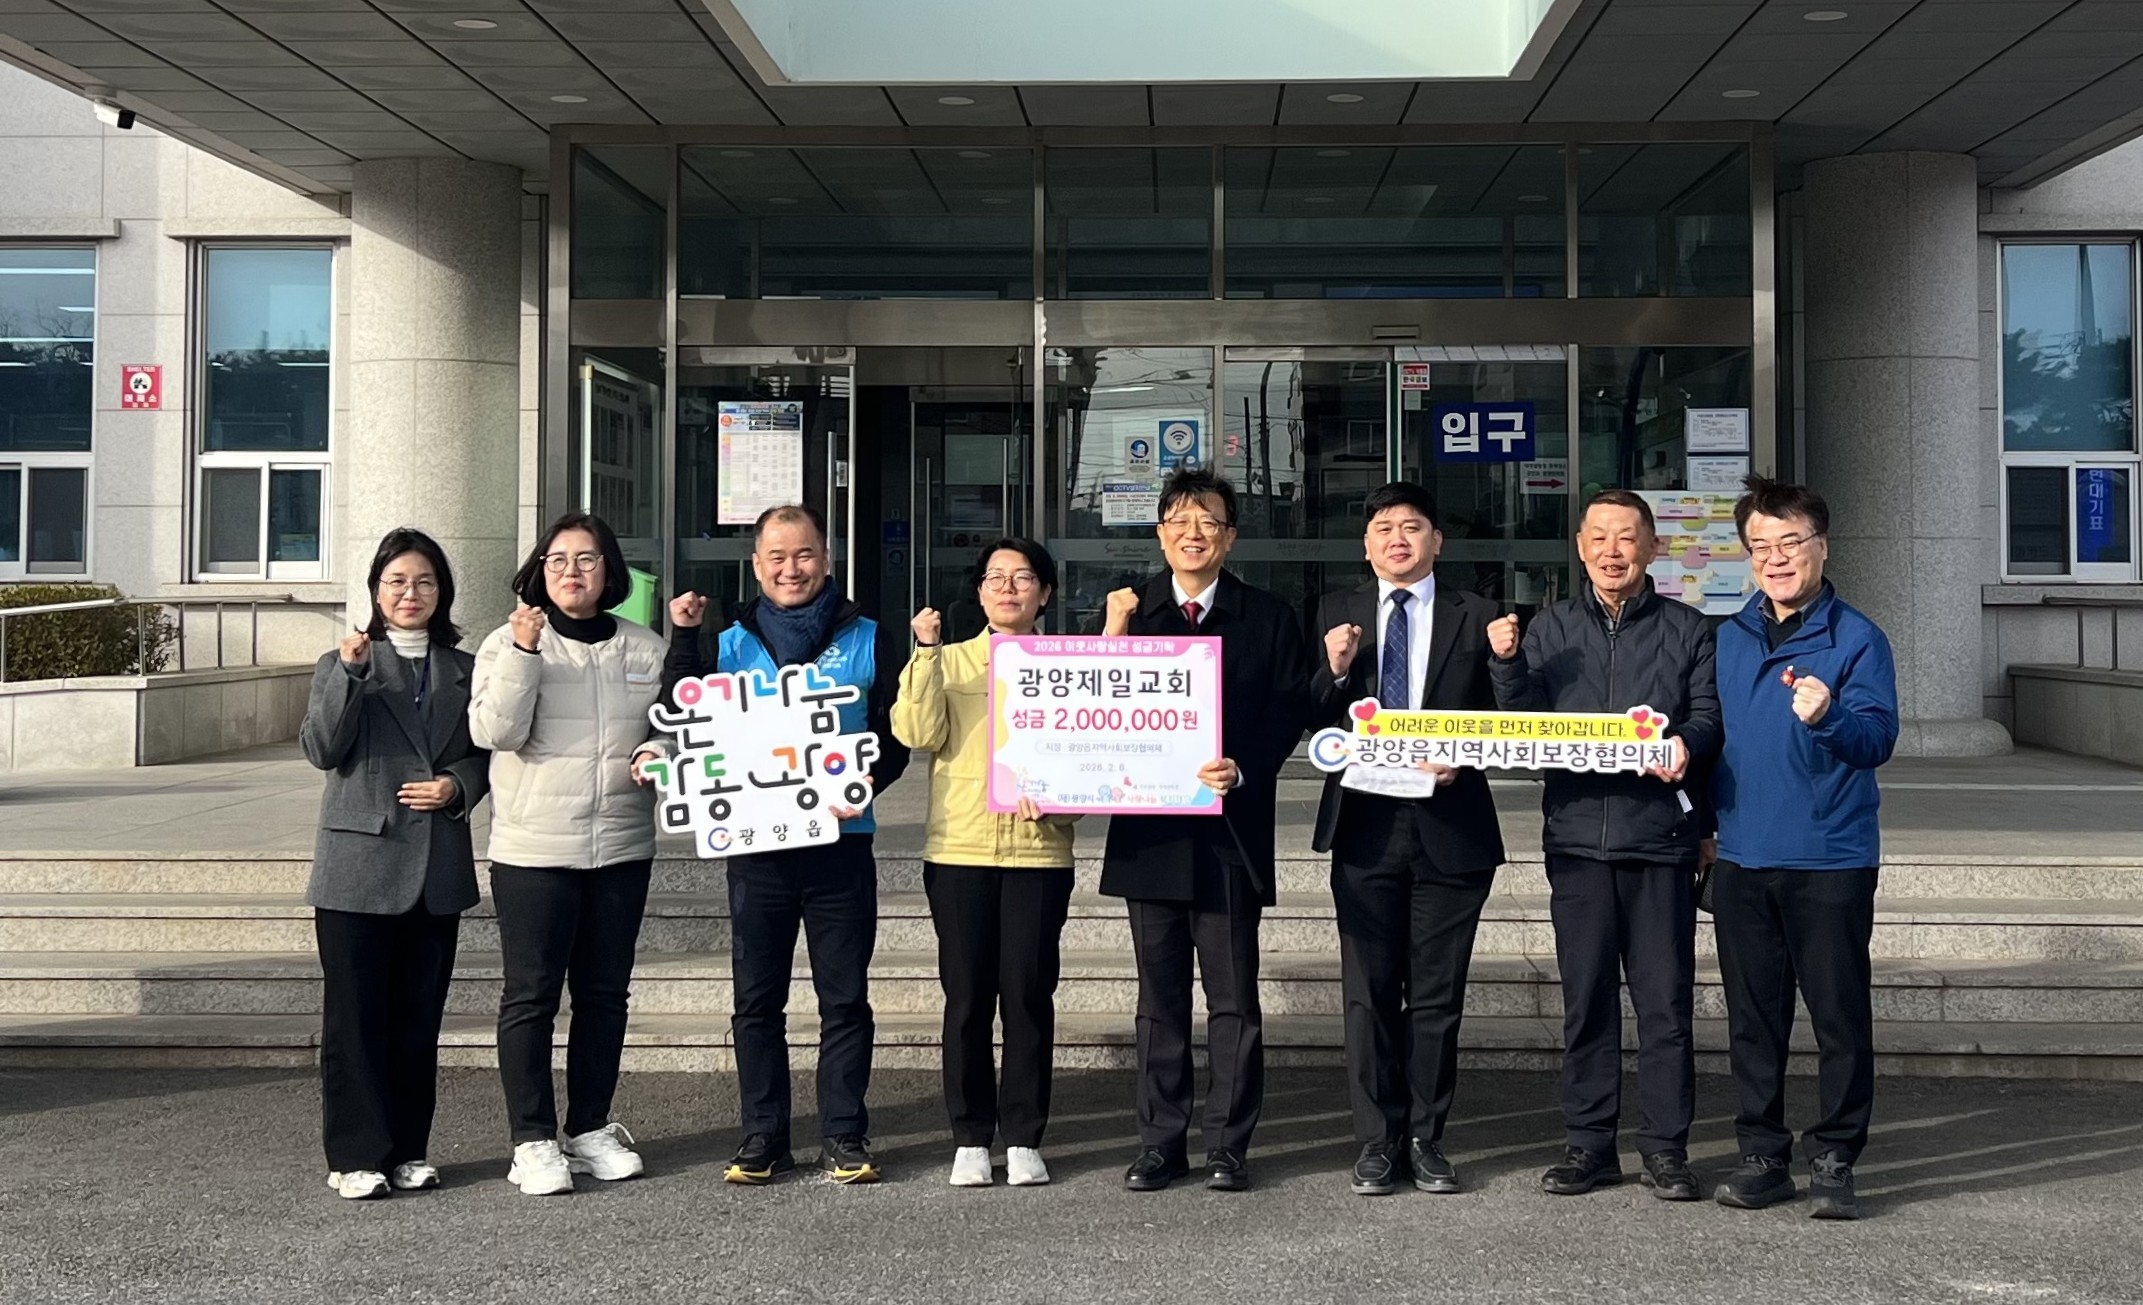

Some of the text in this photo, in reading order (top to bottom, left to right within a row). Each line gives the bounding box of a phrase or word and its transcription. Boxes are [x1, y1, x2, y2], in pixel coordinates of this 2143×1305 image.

[1441, 411, 1527, 454] 입구
[1034, 640, 1176, 653] 2026 이웃사랑실천 성금기탁
[1018, 668, 1192, 698] 광양제일교회
[655, 668, 855, 749] 온기나눔
[1012, 708, 1198, 732] 성금 2,000,000원
[1390, 718, 1628, 737] 어려운 이웃을 먼저 찾아갑니다.
[1068, 742, 1163, 753] 광양읍지역사회보장협의체
[1356, 738, 1672, 769] 광양읍지역사회보장협의체
[644, 754, 743, 827] 감동
